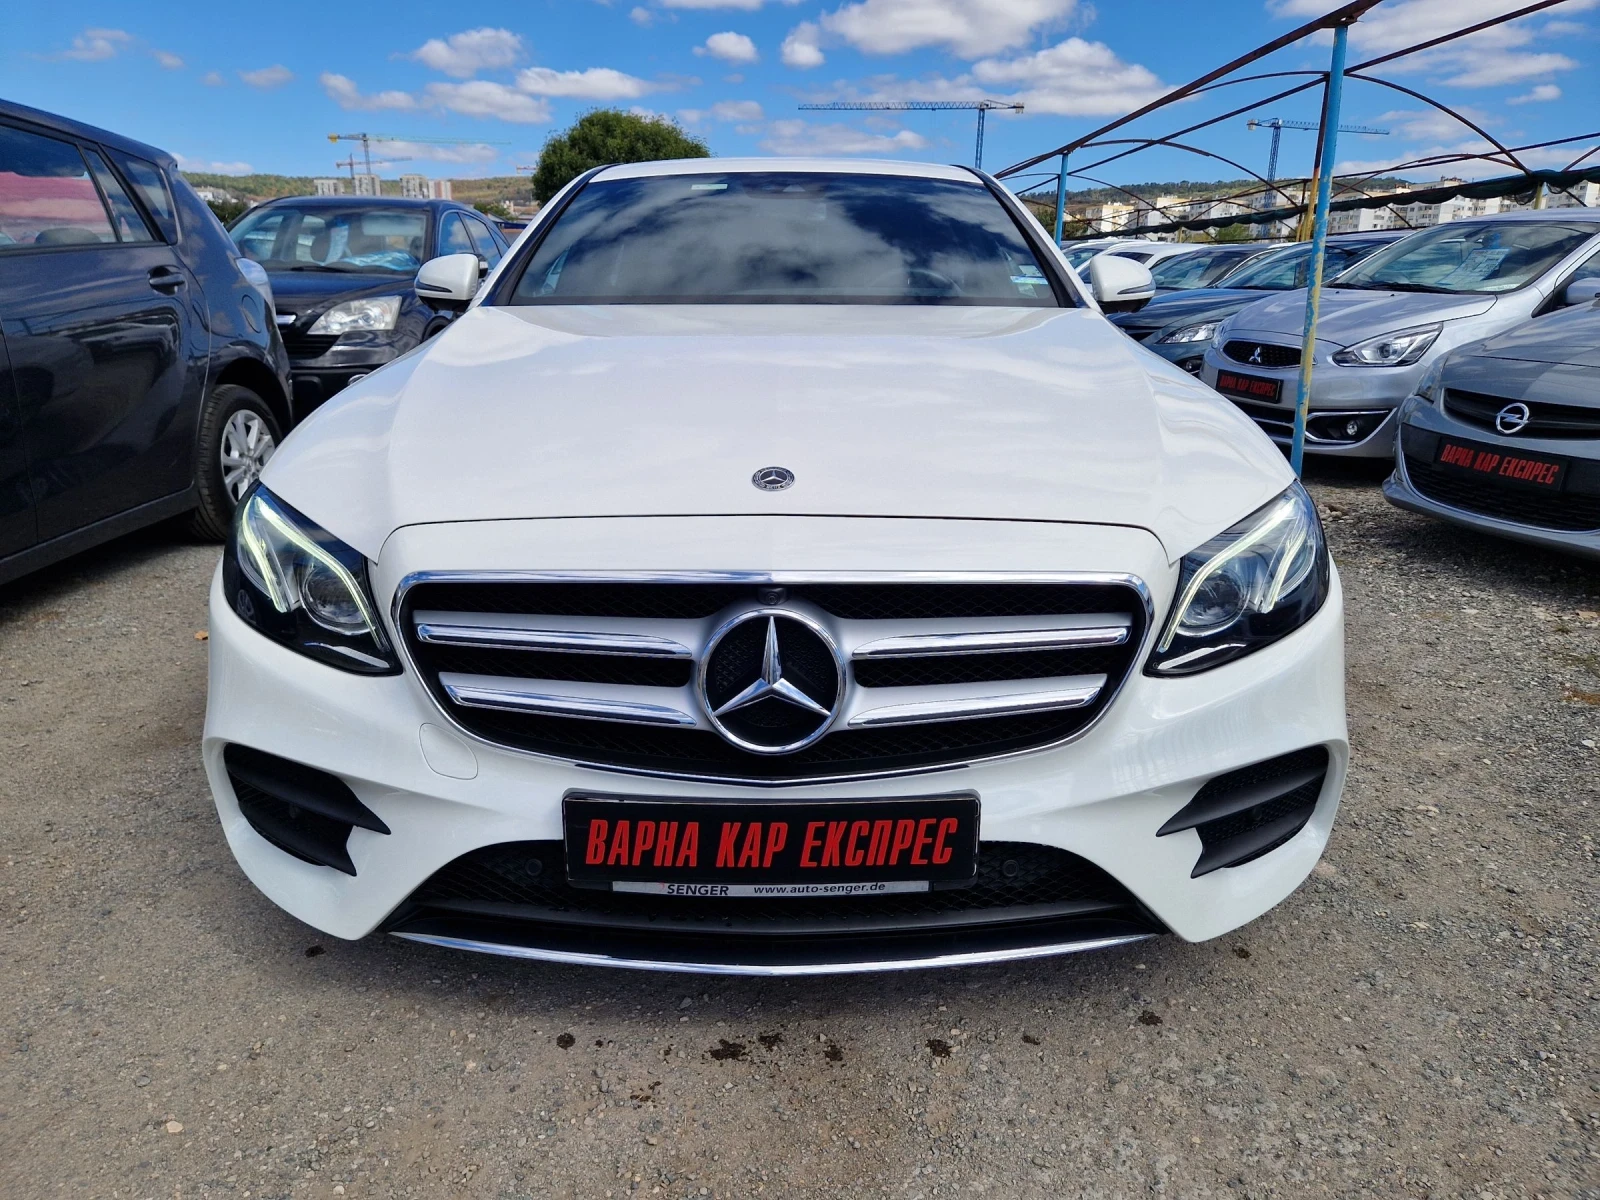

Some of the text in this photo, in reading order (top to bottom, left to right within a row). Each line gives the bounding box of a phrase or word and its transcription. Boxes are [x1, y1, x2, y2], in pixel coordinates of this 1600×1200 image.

[1440, 444, 1560, 485] ВАРНА КАР ЕКСПРЕС
[585, 817, 958, 868] ВАРНА КАР ЕКСПРЕС
[666, 882, 886, 897] SENGER www.auto-senger.de
